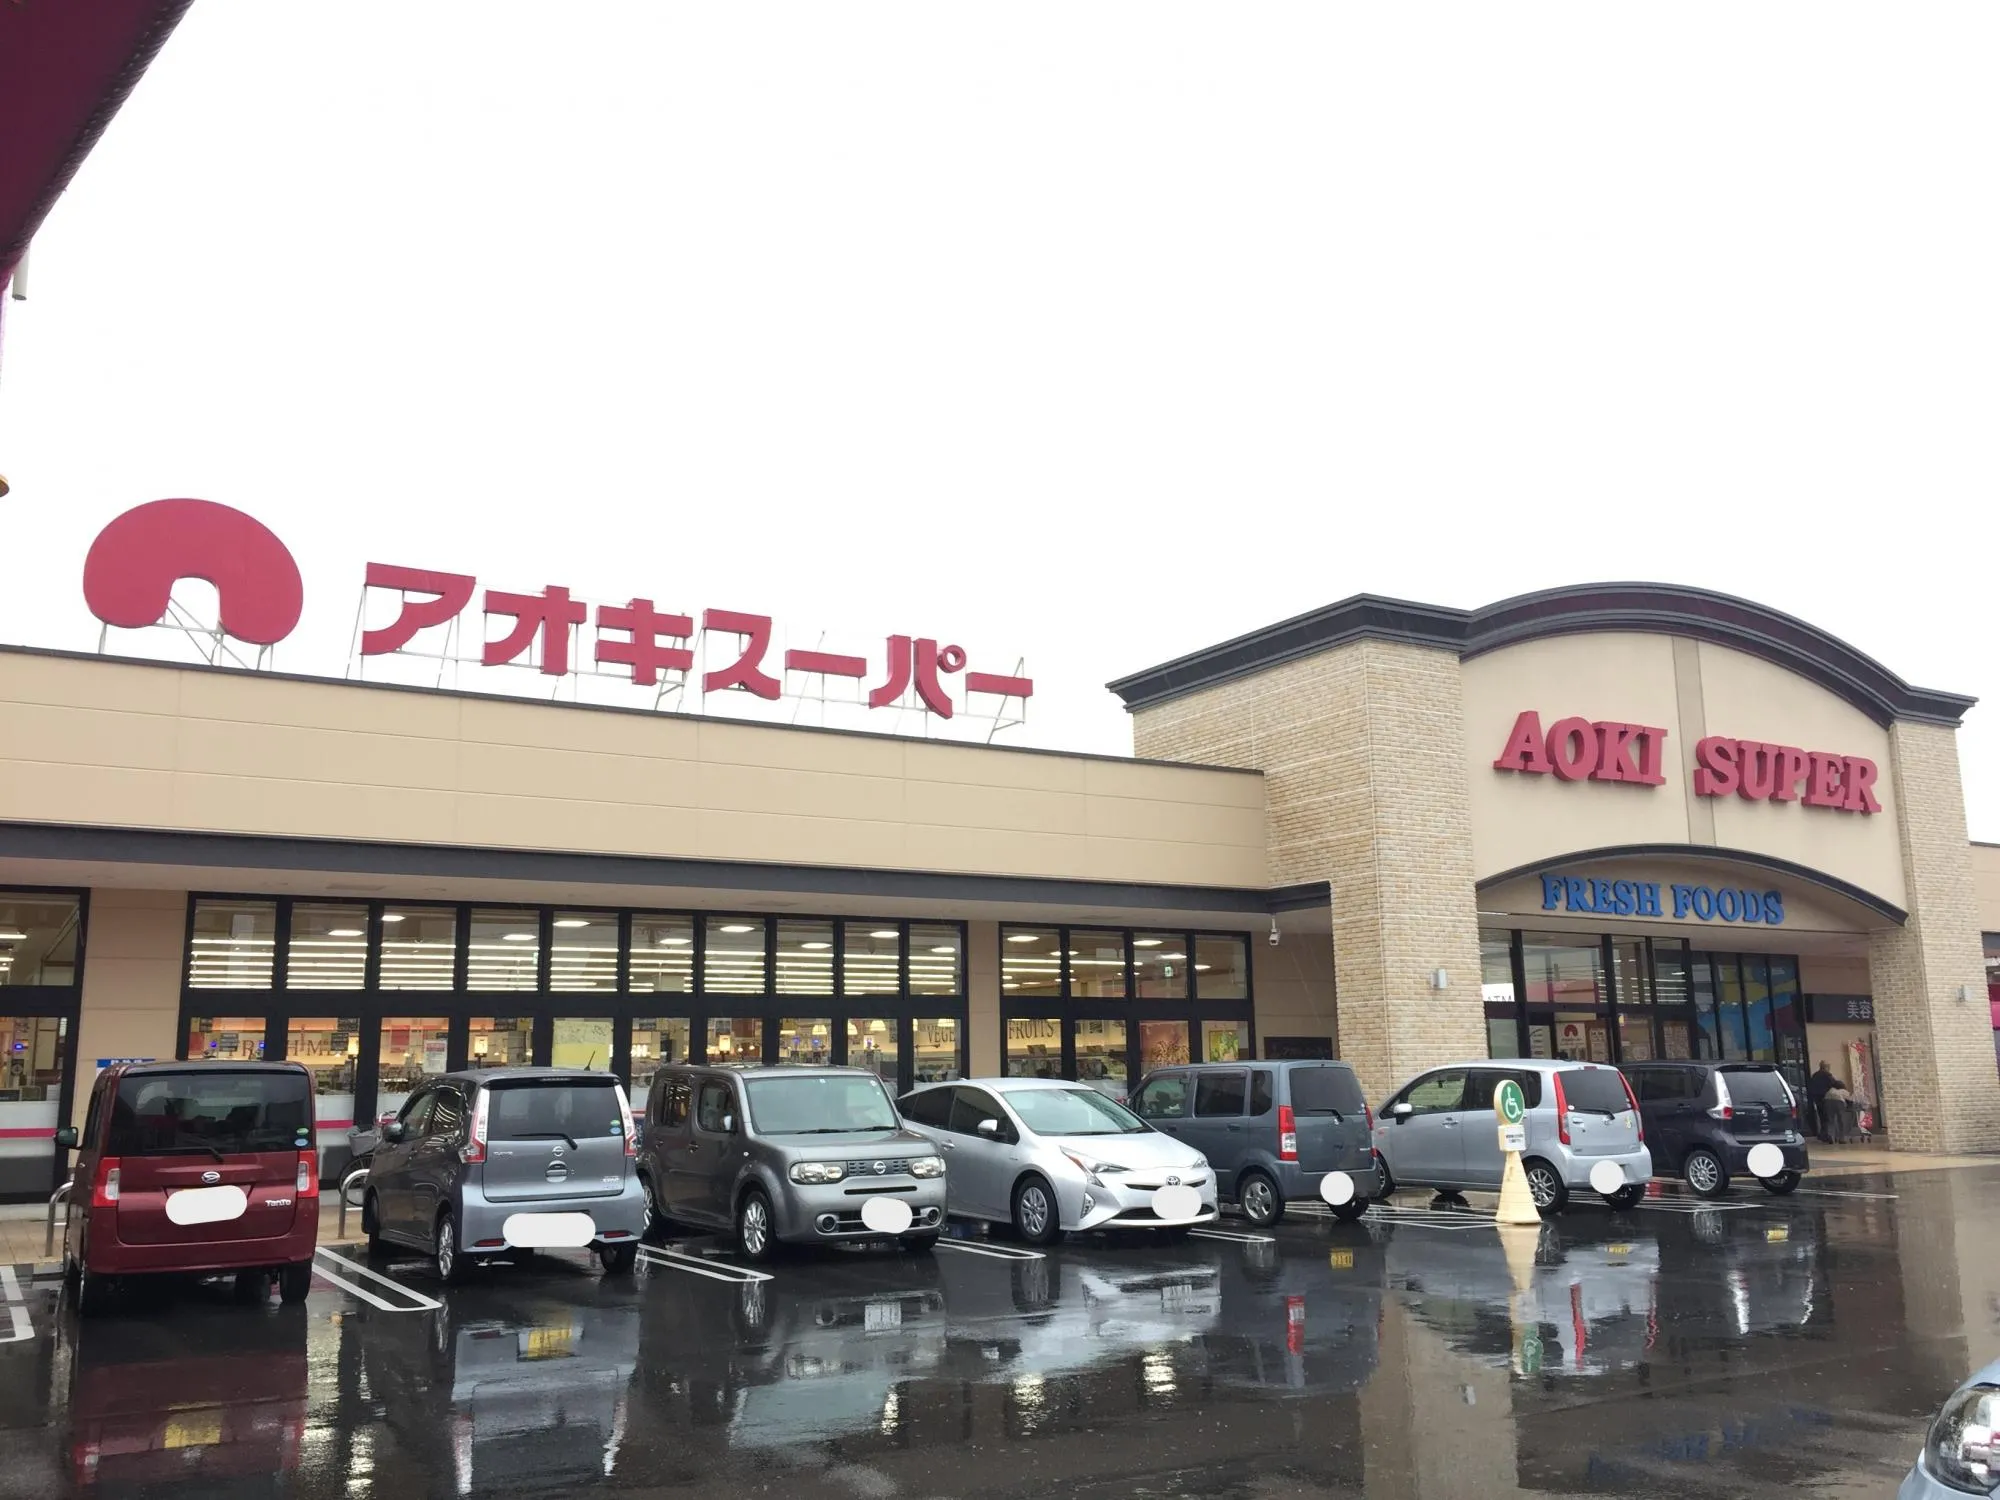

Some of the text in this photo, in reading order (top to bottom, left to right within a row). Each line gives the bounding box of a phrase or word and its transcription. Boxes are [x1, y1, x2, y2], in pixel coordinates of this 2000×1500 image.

[360, 561, 1033, 719] アオキスーパー
[1493, 710, 1881, 814] AOKI SUPER
[1539, 873, 1785, 924] FRESH FOODS
